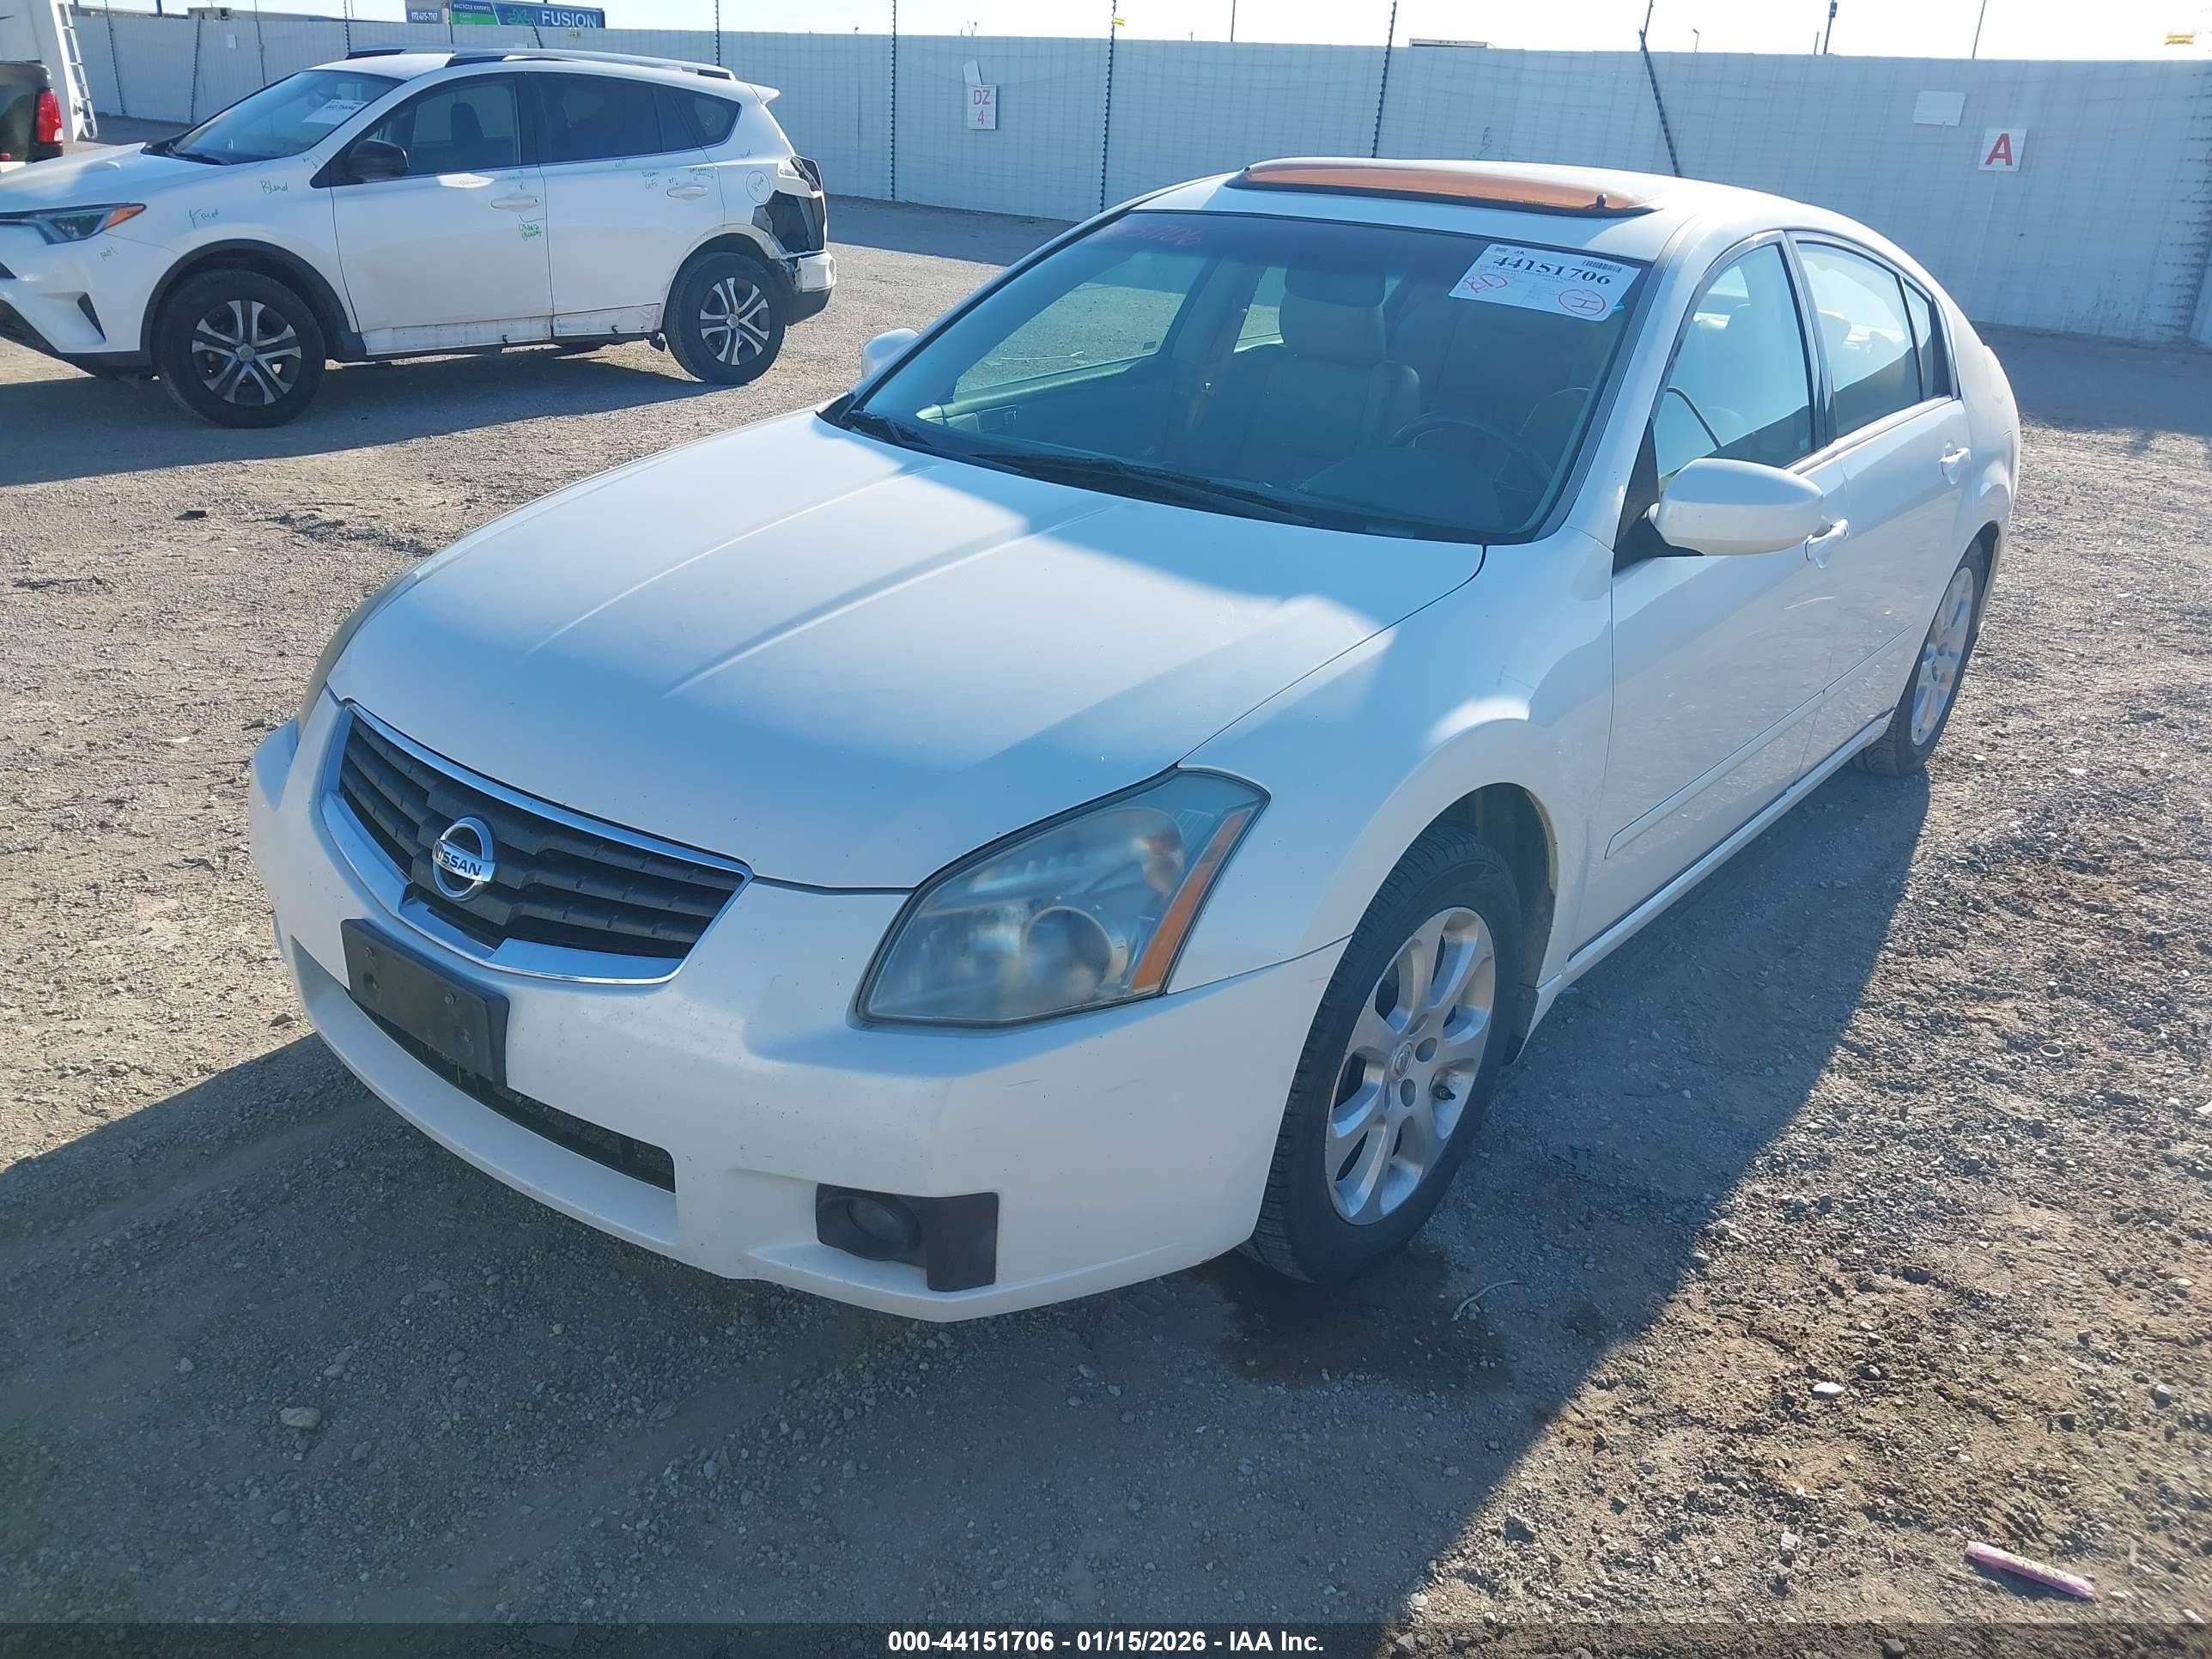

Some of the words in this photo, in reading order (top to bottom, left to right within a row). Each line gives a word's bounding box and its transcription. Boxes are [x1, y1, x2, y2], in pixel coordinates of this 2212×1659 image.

[541, 9, 597, 27] FUSION
[973, 89, 991, 105] DZ
[977, 109, 985, 125] 4
[1984, 133, 2013, 166] A
[1493, 257, 1613, 284] 44151706
[434, 843, 483, 877] NISSAN
